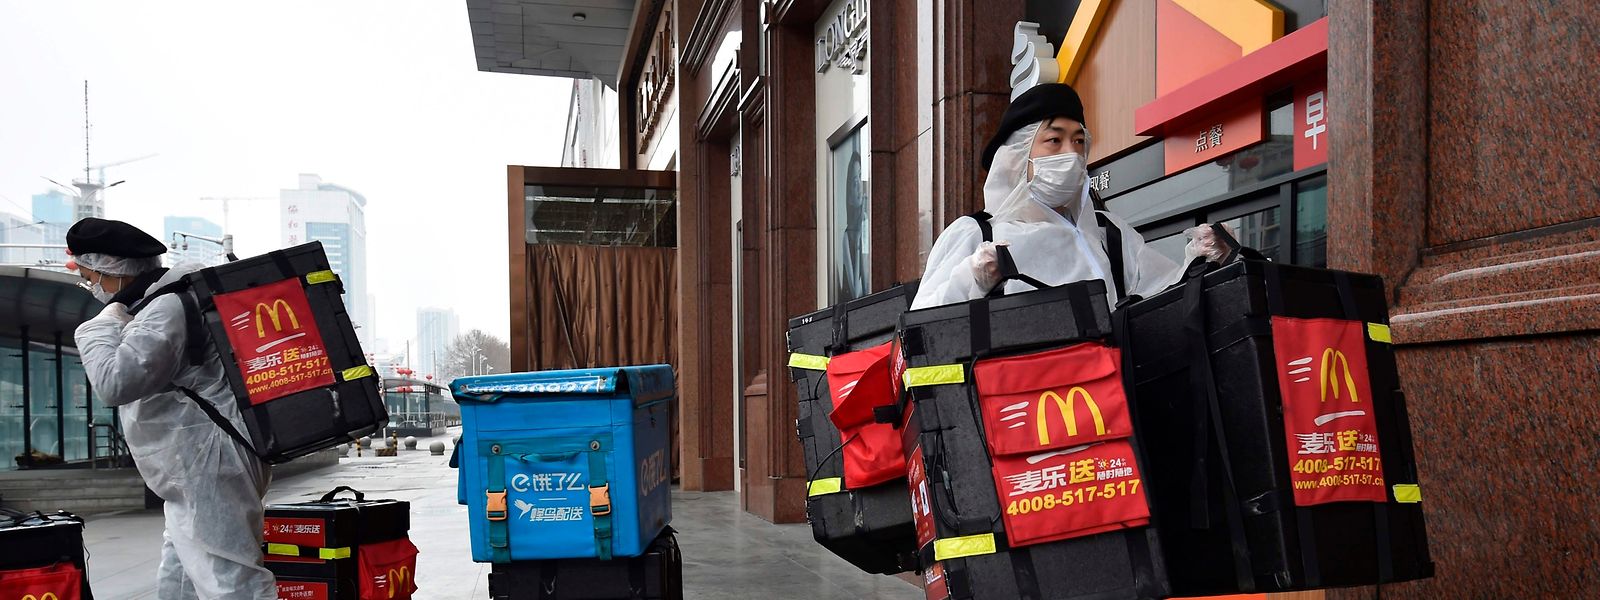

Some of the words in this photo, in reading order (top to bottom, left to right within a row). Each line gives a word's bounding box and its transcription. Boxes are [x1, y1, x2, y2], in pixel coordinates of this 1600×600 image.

[1195, 124, 1224, 153] 点餐
[1089, 170, 1111, 192] 取餐
[245, 348, 300, 373] 麦乐送
[246, 356, 328, 385] 4008-517-517
[248, 368, 333, 395] www.4008-517-517.cn
[1293, 430, 1358, 455] 麦乐送
[1003, 458, 1095, 497] 麦乐送
[1293, 456, 1381, 474] 4008-517-517
[1007, 479, 1140, 516] 4008-517-517
[530, 506, 583, 522] 蜂鸟配送
